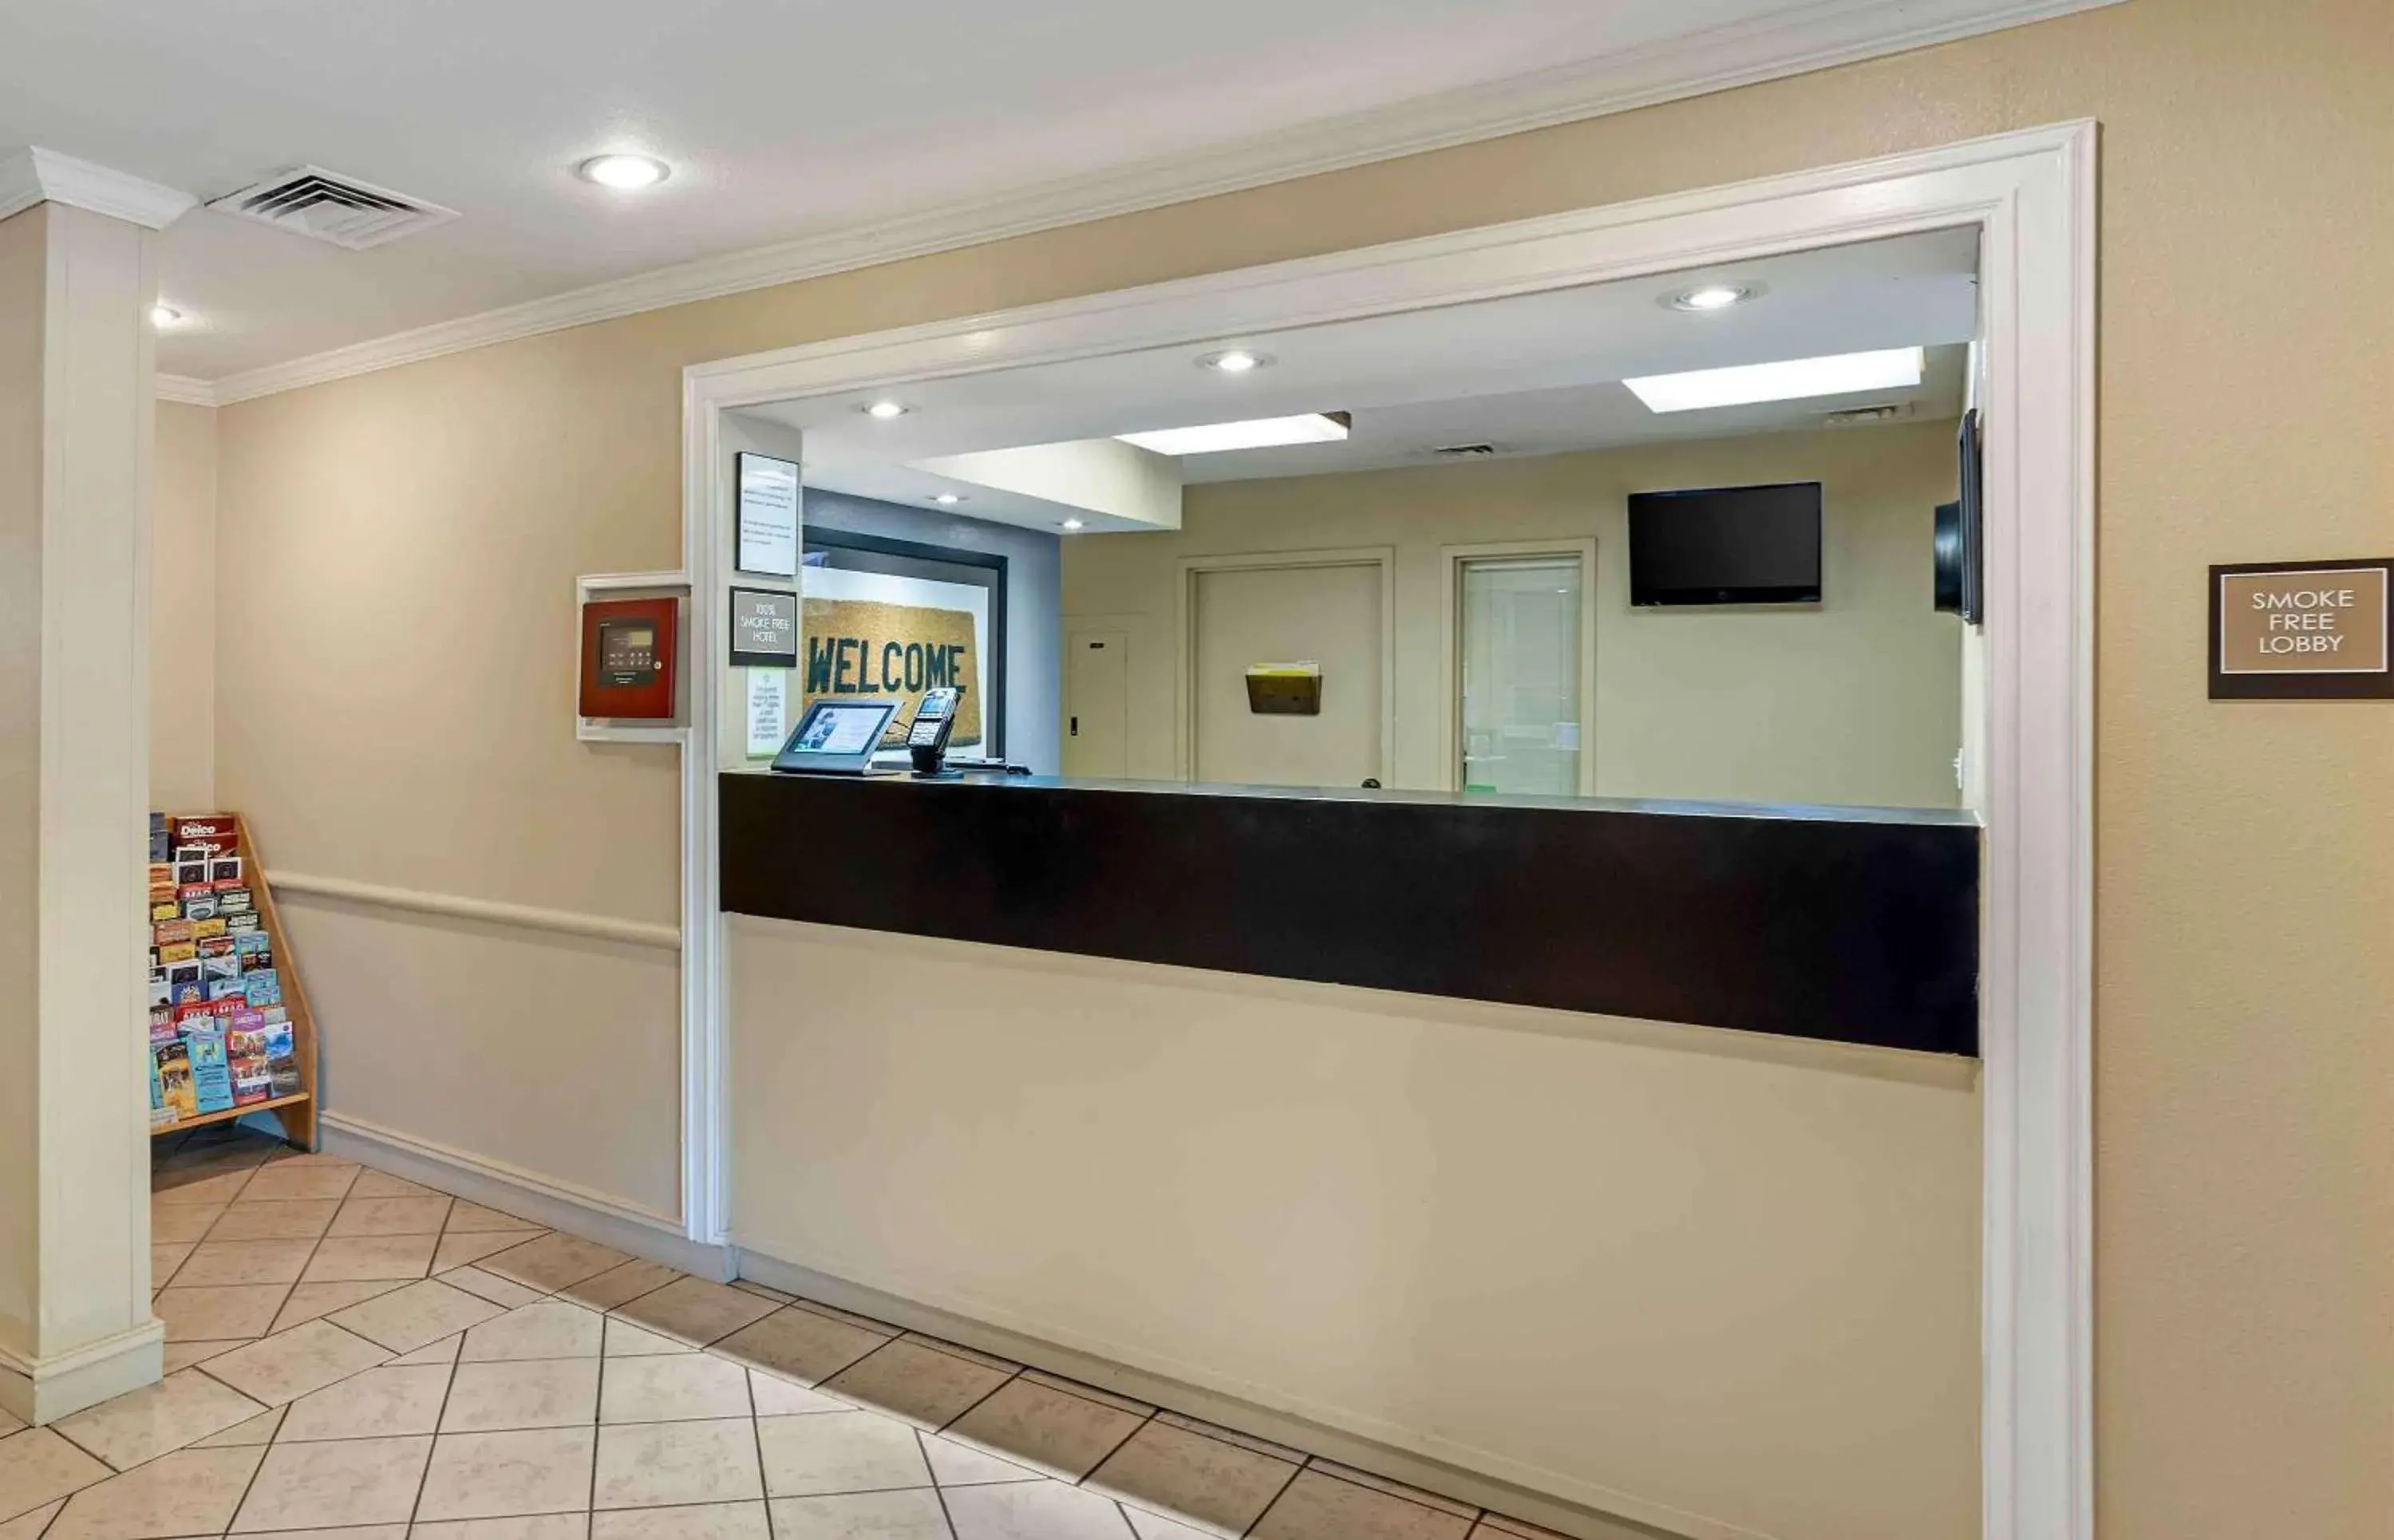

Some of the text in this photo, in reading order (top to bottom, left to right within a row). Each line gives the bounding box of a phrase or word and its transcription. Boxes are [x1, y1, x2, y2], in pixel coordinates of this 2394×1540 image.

[2251, 590, 2355, 610] SMOKE
[740, 615, 791, 630] SMOKE FREE
[2269, 613, 2334, 631] FREE
[753, 630, 777, 643] HOTEL
[2259, 635, 2345, 654] LOBBY
[806, 637, 966, 694] WELCOME
